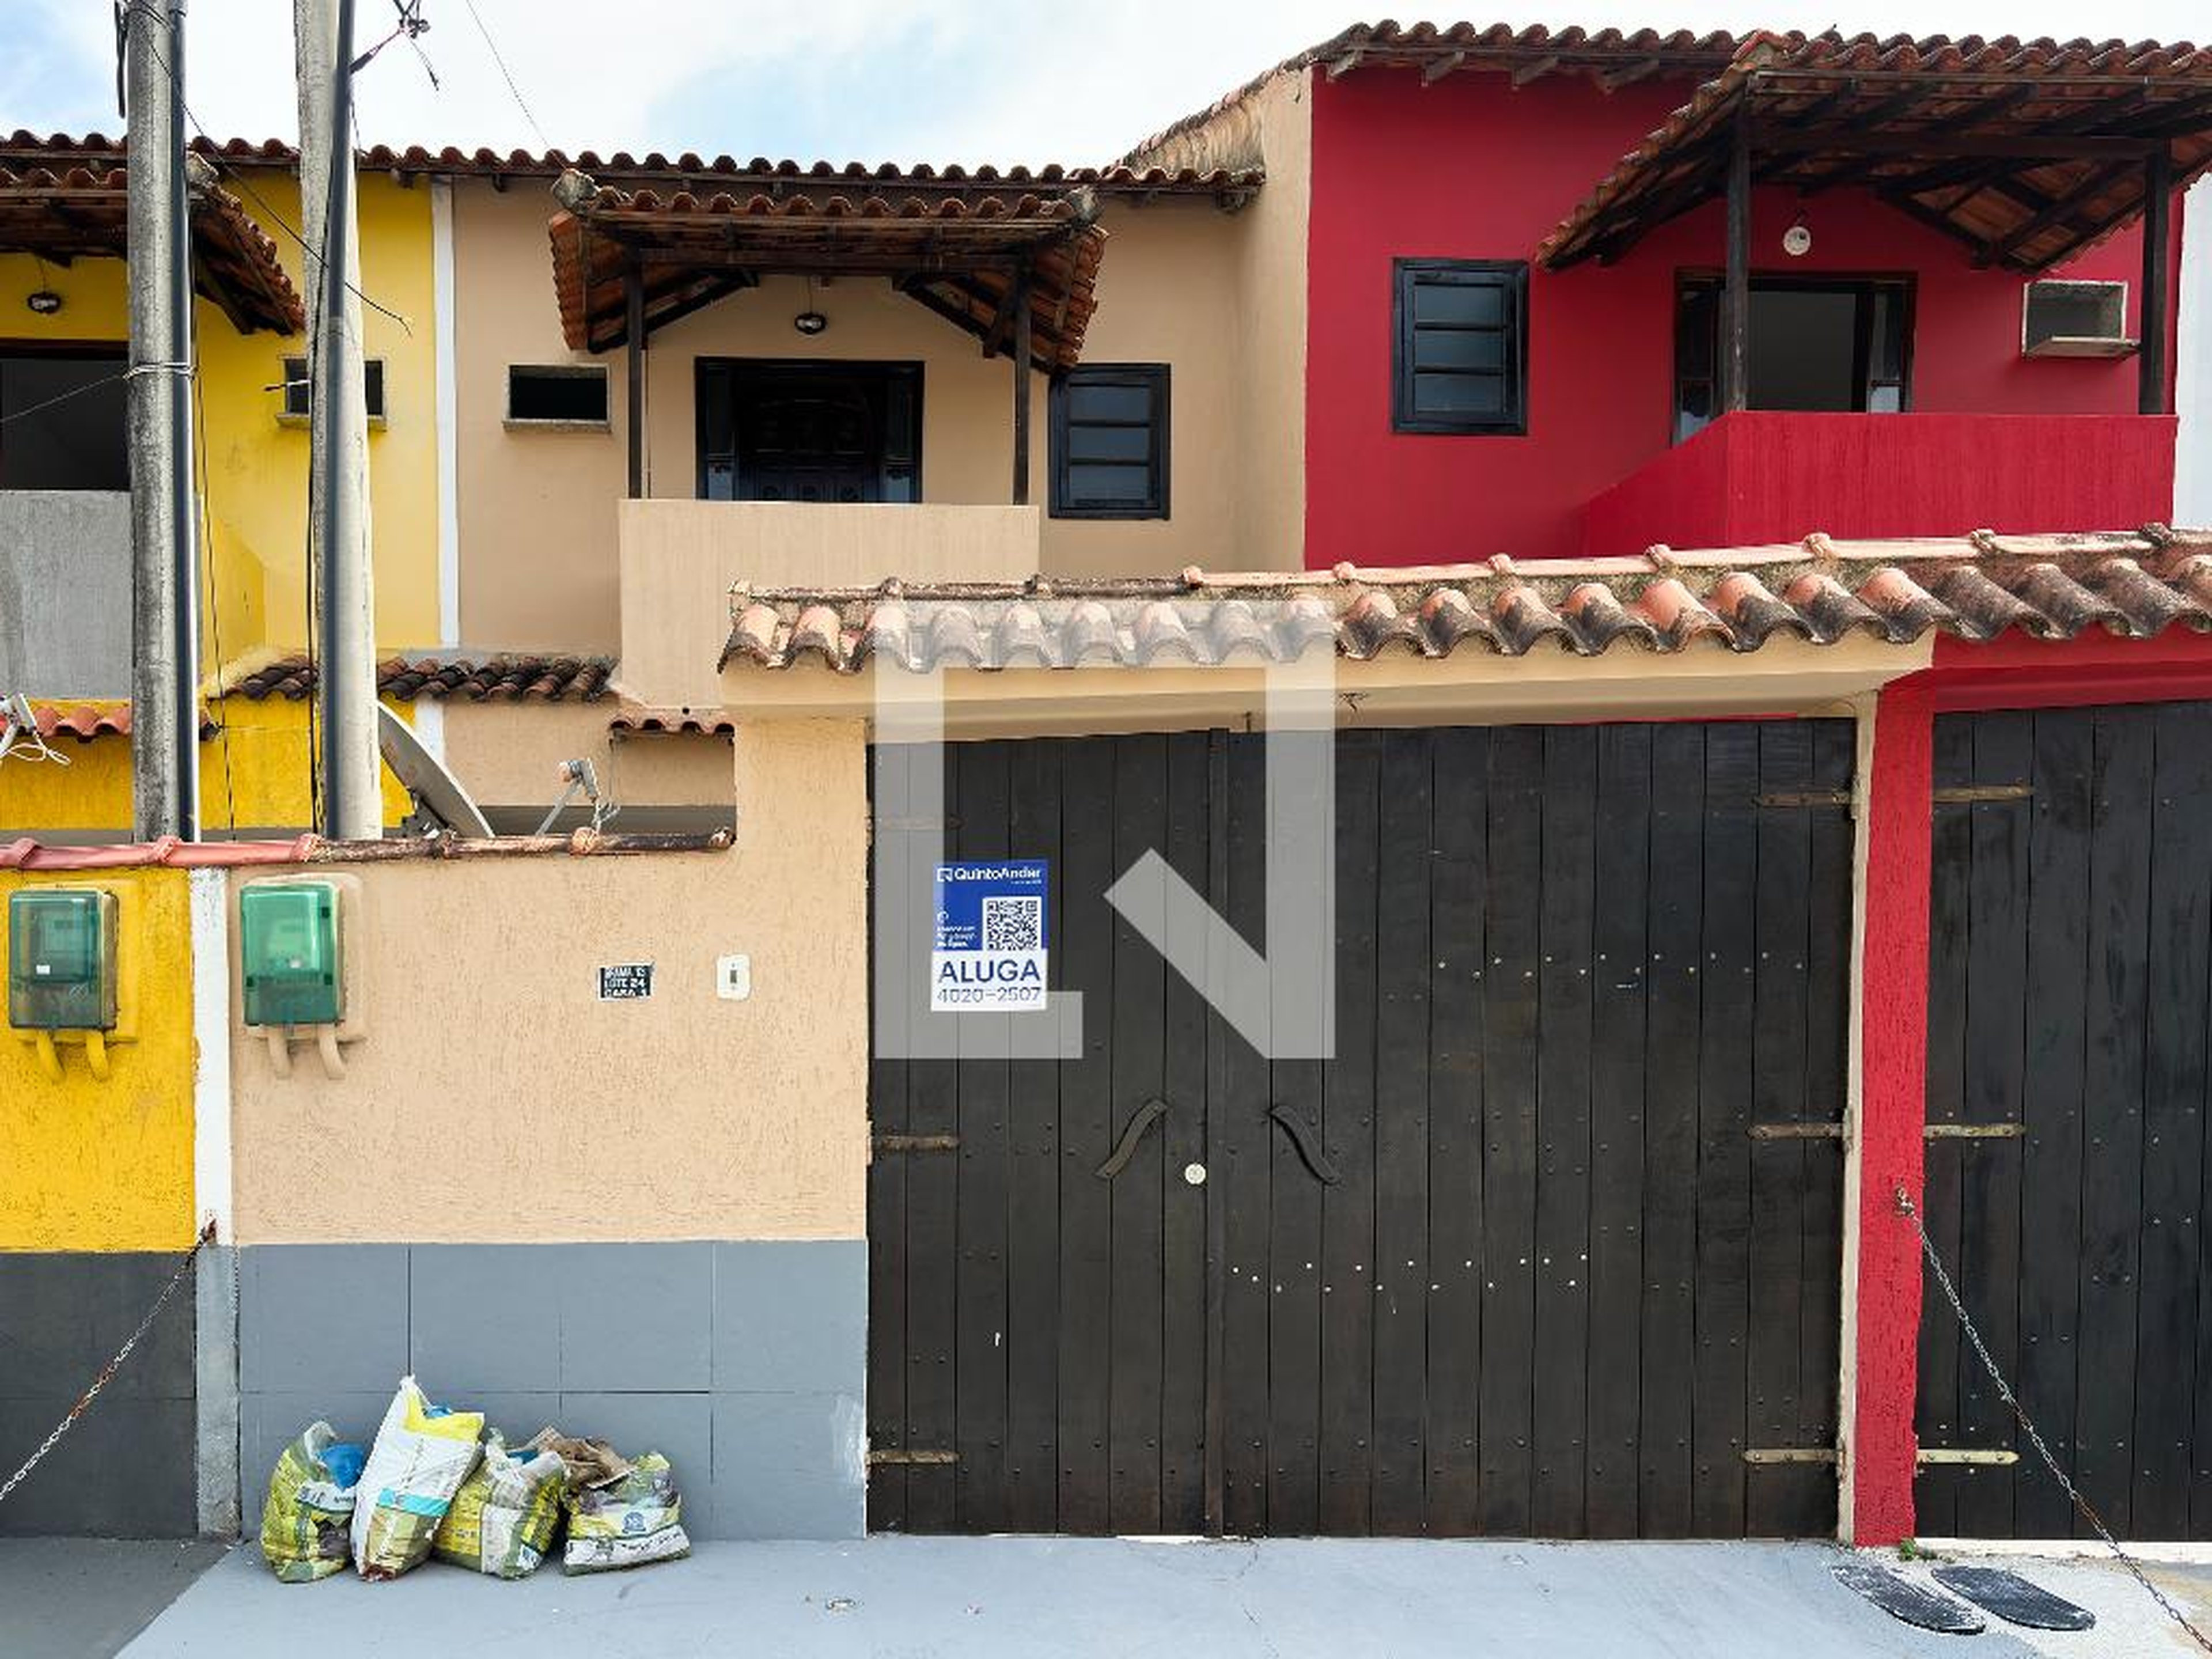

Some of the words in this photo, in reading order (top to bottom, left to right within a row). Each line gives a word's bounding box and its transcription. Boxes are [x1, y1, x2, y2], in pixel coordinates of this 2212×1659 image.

[939, 959, 1040, 983] ALUGA
[630, 978, 646, 988] 24
[938, 987, 1041, 1003] 4020-2507
